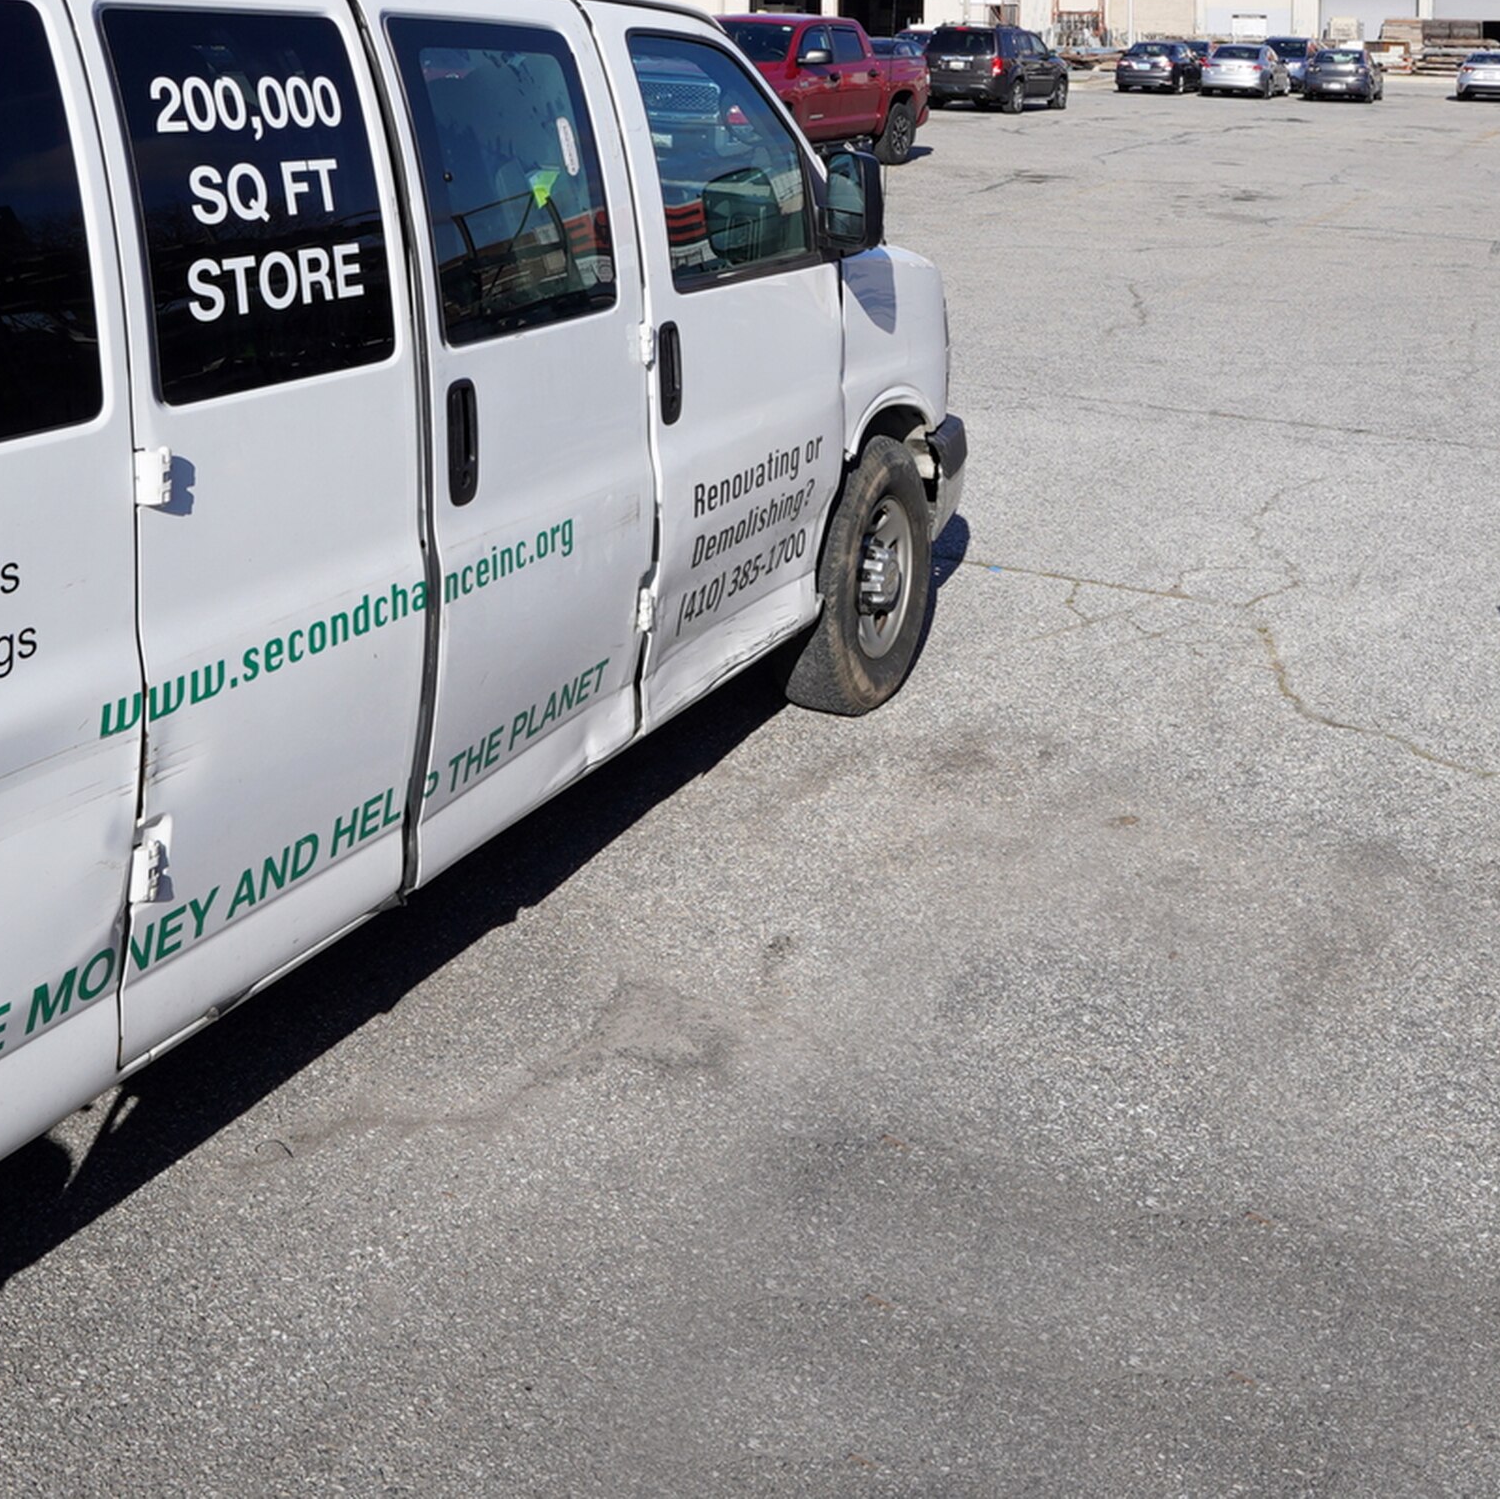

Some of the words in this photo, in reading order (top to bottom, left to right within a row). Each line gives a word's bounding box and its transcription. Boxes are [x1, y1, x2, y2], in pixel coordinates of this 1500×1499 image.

[149, 75, 342, 141] 200,000
[188, 162, 270, 225] SQ
[280, 158, 338, 216] FT
[186, 243, 365, 322] STORE
[693, 445, 800, 519] Renovating
[805, 435, 824, 464] or
[690, 478, 816, 570] Demolishing?
[676, 568, 728, 637] (410)
[727, 527, 806, 598] 385-1700
[99, 518, 576, 739] www.secondchanceinc.org
[23, 885, 221, 1036] MONEY
[226, 832, 319, 923] AND
[449, 726, 504, 793] THE
[508, 658, 610, 752] PLANET
